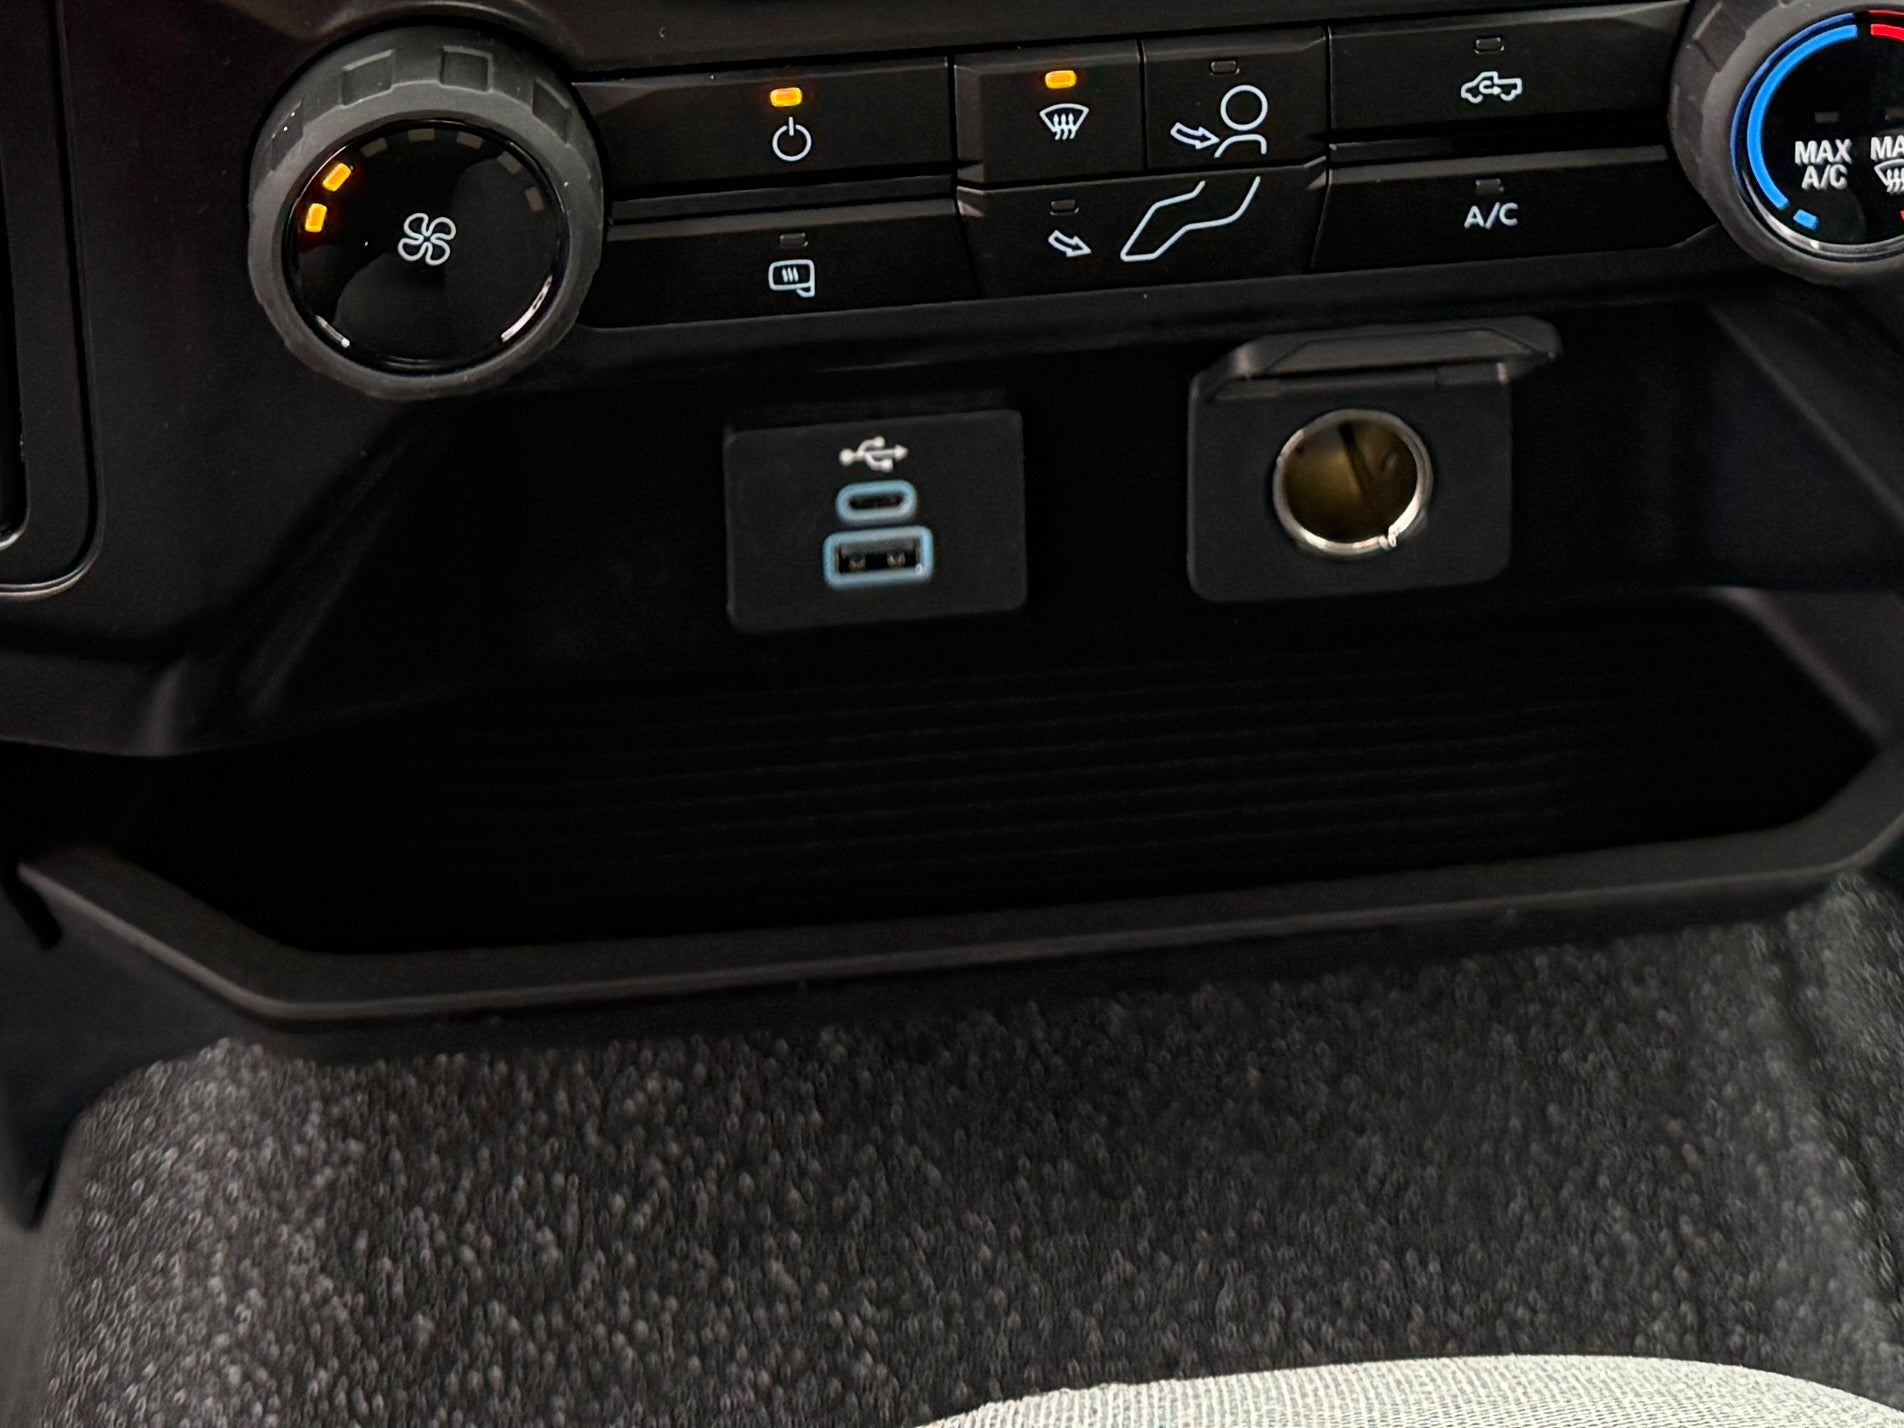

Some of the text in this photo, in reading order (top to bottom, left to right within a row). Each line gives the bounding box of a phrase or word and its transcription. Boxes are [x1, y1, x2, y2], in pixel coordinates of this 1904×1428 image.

[1795, 137, 1852, 165] MAX
[1801, 164, 1848, 191] A/C
[1463, 200, 1519, 232] A/C
